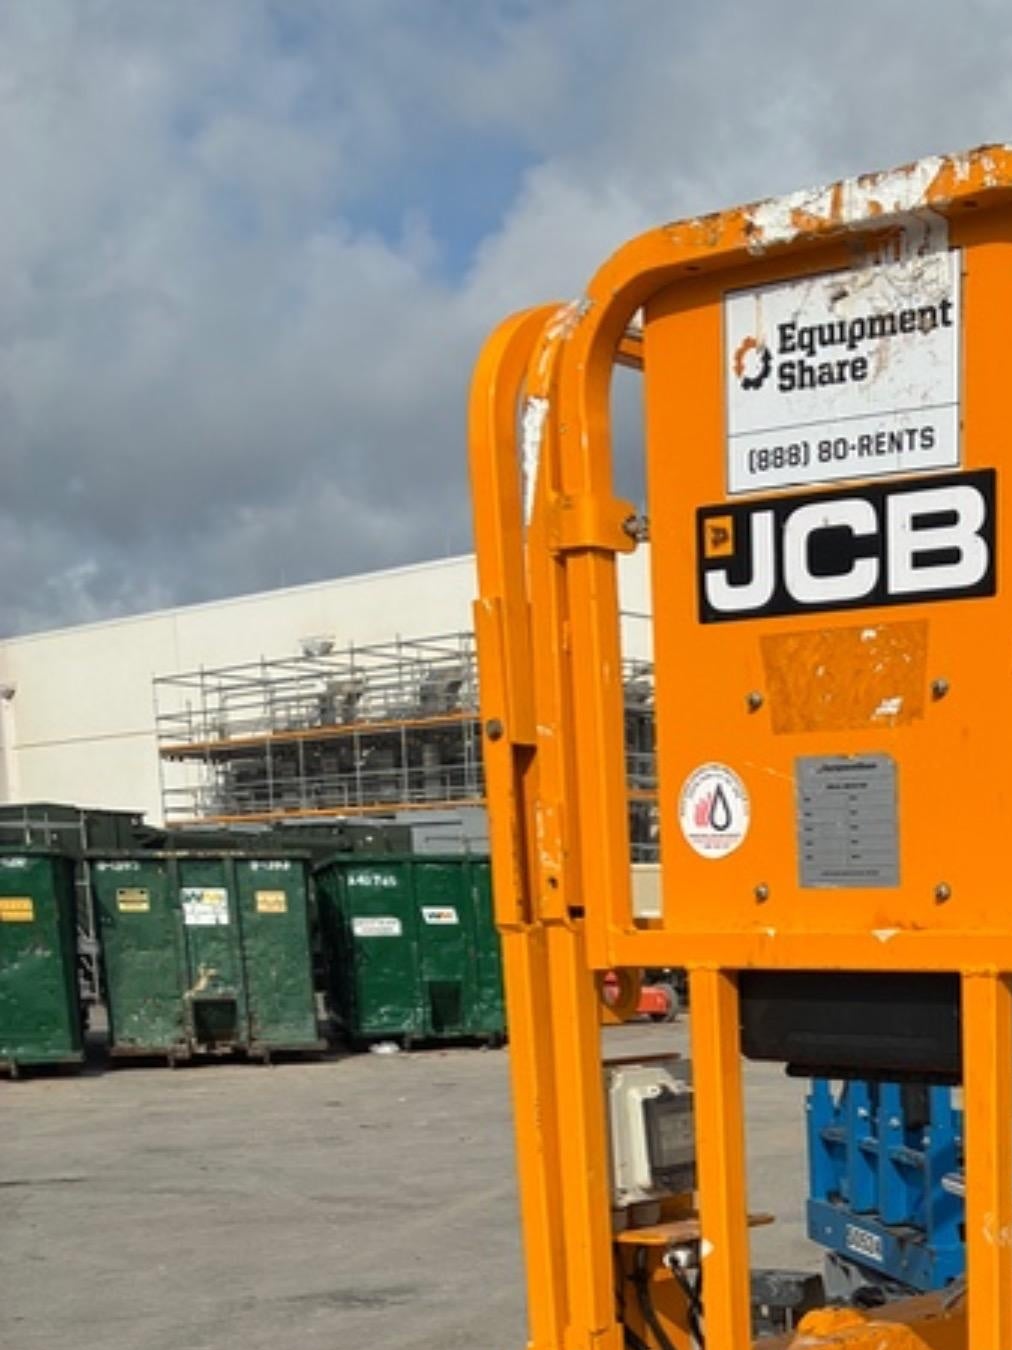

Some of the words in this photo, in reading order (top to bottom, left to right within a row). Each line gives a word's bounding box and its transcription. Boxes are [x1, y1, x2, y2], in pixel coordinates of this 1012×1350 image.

[777, 298, 954, 358] Equipment
[777, 354, 869, 393] Share
[748, 440, 810, 475] (888)
[817, 426, 936, 465] 80-RENTS
[704, 484, 989, 613] JCB
